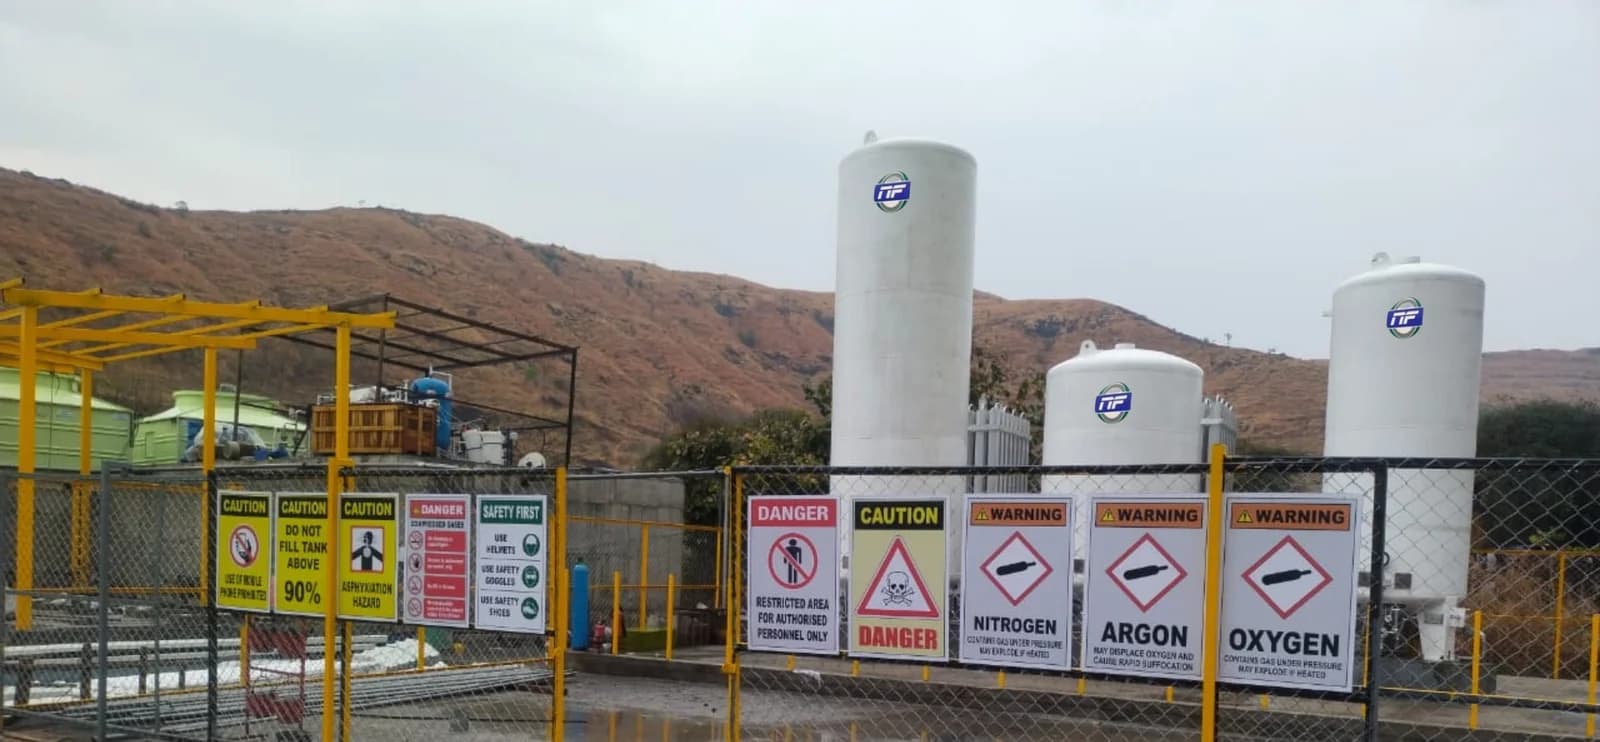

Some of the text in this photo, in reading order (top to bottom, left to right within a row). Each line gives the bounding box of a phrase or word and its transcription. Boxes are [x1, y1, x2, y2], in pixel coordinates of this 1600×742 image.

[223, 500, 265, 512] CAUTION
[282, 501, 326, 514] CAUTION
[344, 502, 392, 516] CAUTION
[422, 504, 463, 514] DANGER
[483, 505, 540, 519] SAFETY FIRST
[758, 506, 828, 521] DANGER
[860, 506, 938, 524] CAUTION
[991, 508, 1062, 521] WARNING
[1118, 509, 1198, 522] WARNING
[1256, 510, 1345, 524] WARNING
[286, 524, 321, 536] DO NOT
[494, 533, 508, 542] USE
[280, 541, 328, 554] FILL TANK
[486, 546, 515, 554] HELMETS
[287, 557, 320, 570] ABOVE
[482, 565, 520, 574] USE SAFETY
[485, 576, 515, 586] GOGGLES
[284, 580, 321, 604] 90%
[342, 582, 392, 594] ASPHYXIATION
[353, 596, 381, 608] HAZARD
[480, 596, 519, 605] USE SAFETY
[756, 596, 829, 610] RESTRICTED AREA
[489, 608, 510, 617] SHOES
[758, 614, 827, 626] FOR AUTHORISED
[974, 616, 1056, 635] NITROGEN
[758, 628, 828, 642] PERSONNEL ONLY
[859, 625, 937, 650] DANGER
[1101, 621, 1188, 648] ARGON
[1229, 628, 1340, 657] OXYGEN
[1110, 648, 1144, 657] DISPLACE
[1146, 650, 1176, 660] OXYGEN
[1178, 652, 1194, 660] AND
[1142, 659, 1193, 671] SUFFOCATION
[1224, 654, 1343, 670] CONTAINS GAS UNDER PRESSURE
[1254, 666, 1288, 676] EXPLODE
[1297, 670, 1326, 679] HEATED
